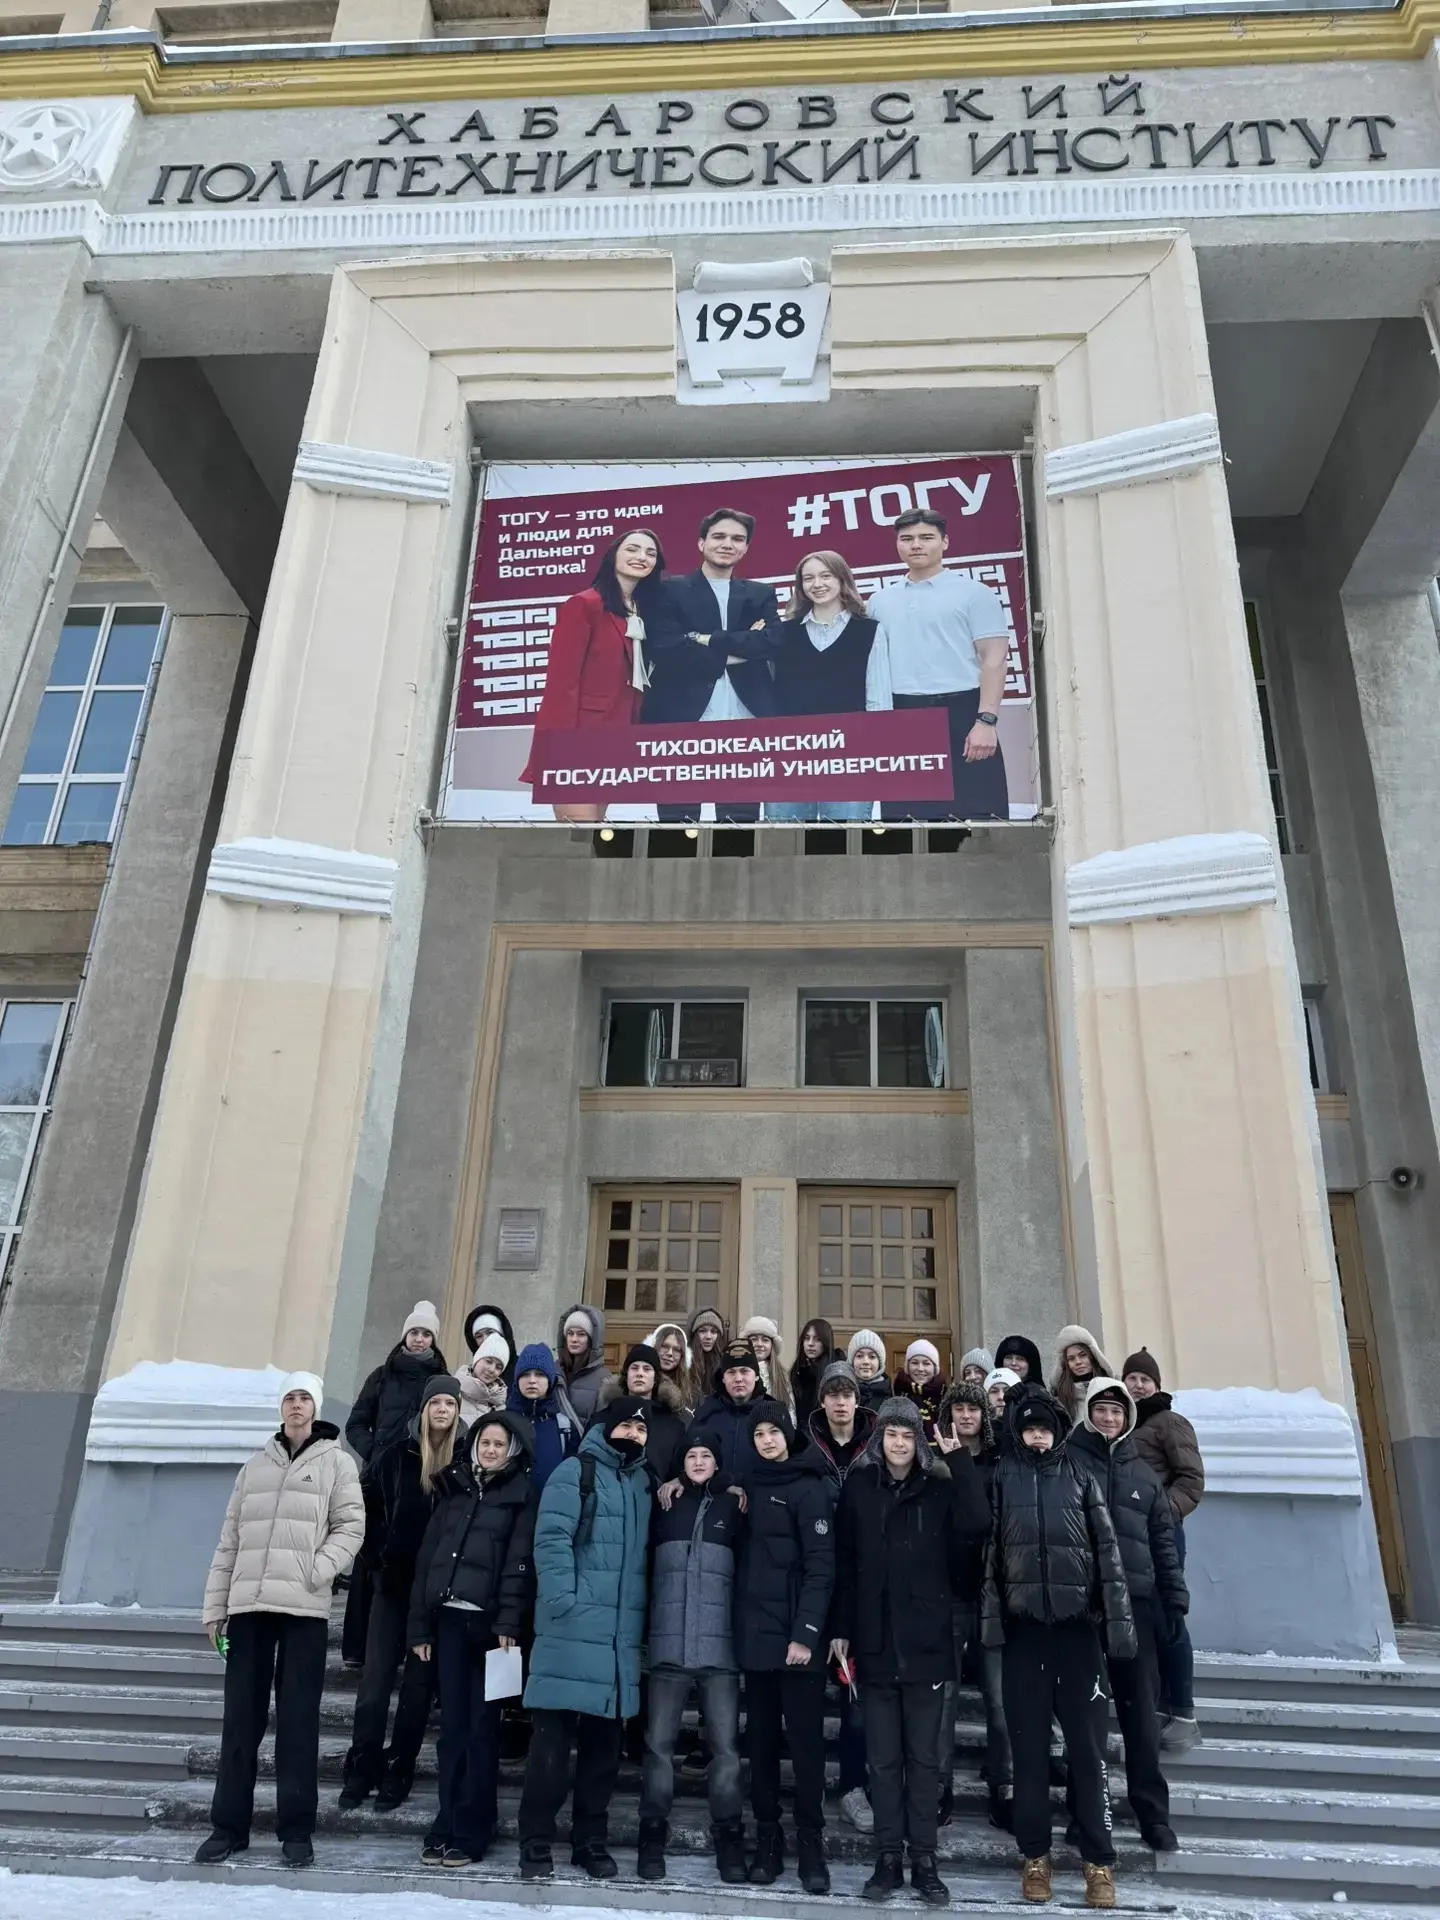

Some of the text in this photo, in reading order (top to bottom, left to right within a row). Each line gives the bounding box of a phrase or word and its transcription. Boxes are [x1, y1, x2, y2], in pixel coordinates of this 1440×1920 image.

[378, 74, 1146, 146] ХАБАРОВСКИЙ
[147, 114, 1396, 206] ПОЛИТЕХНИЧЕСКИЙ ИНСТИТУТ
[696, 302, 805, 342] 1958
[498, 510, 550, 527] ТОГУ
[575, 508, 609, 521] это
[614, 504, 664, 519] идеи
[787, 473, 991, 538] #ТОГУ
[498, 525, 614, 544] и люди для
[498, 543, 595, 564] Дальнего
[499, 558, 586, 579] Востока!
[635, 729, 845, 757] ТИХООКЕАНСКИЙ
[542, 753, 948, 787] ГОСУДАРСТВЕННЫЙ УНИВЕРСИТЕТ
